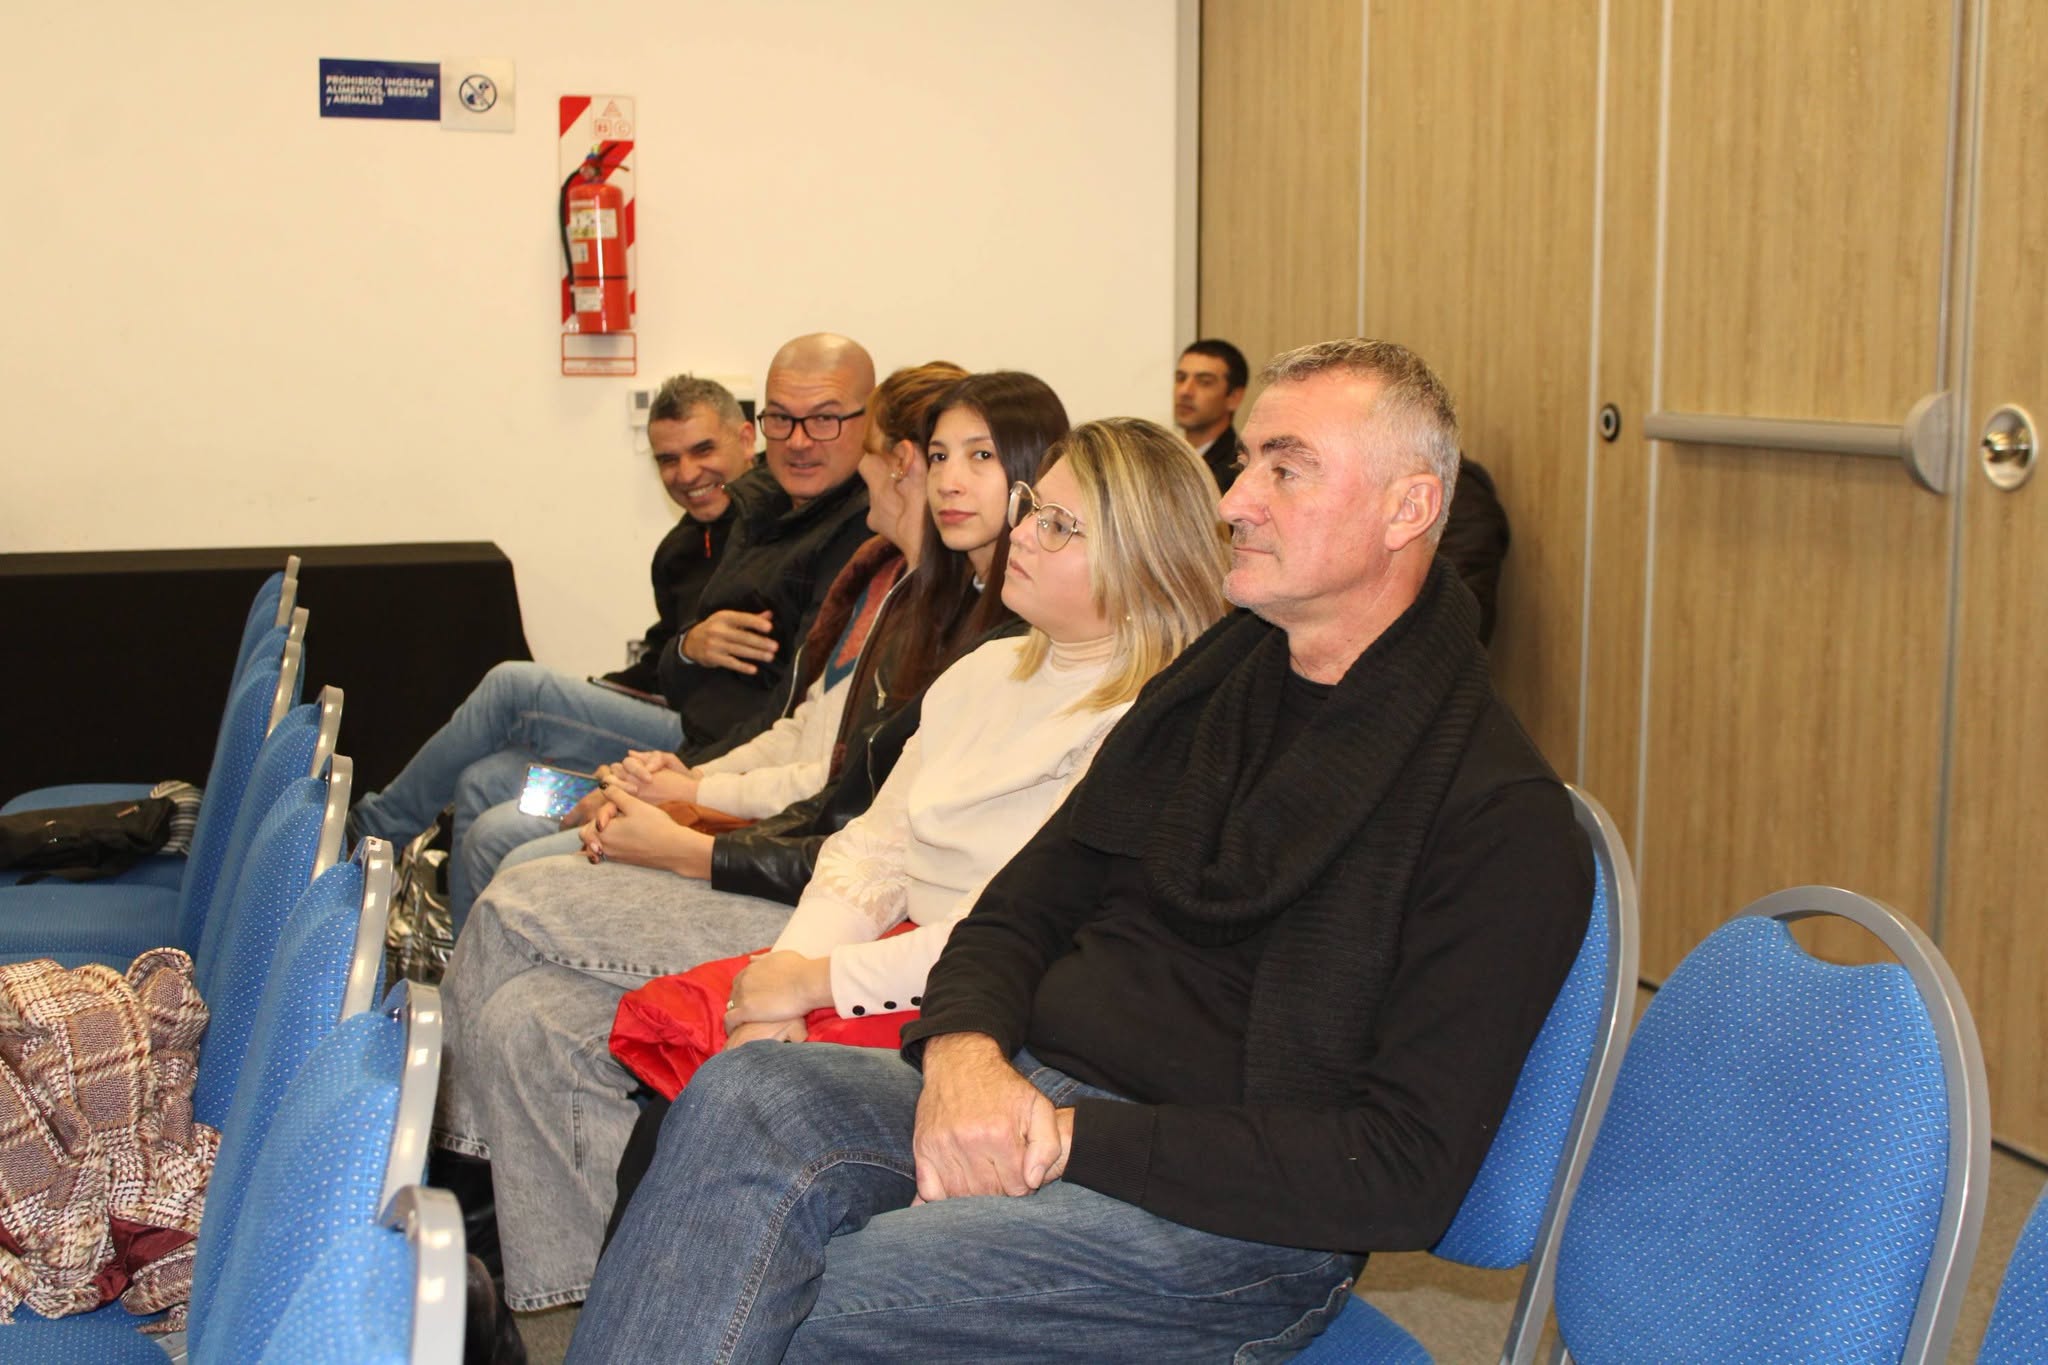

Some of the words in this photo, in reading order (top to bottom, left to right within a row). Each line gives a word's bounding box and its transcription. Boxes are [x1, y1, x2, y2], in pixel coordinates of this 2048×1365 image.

[326, 75, 383, 86] PROHIBIDO
[384, 77, 434, 88] INGRESAR
[387, 87, 428, 98] BEBIDAS
[333, 95, 384, 105] ANIMALES
